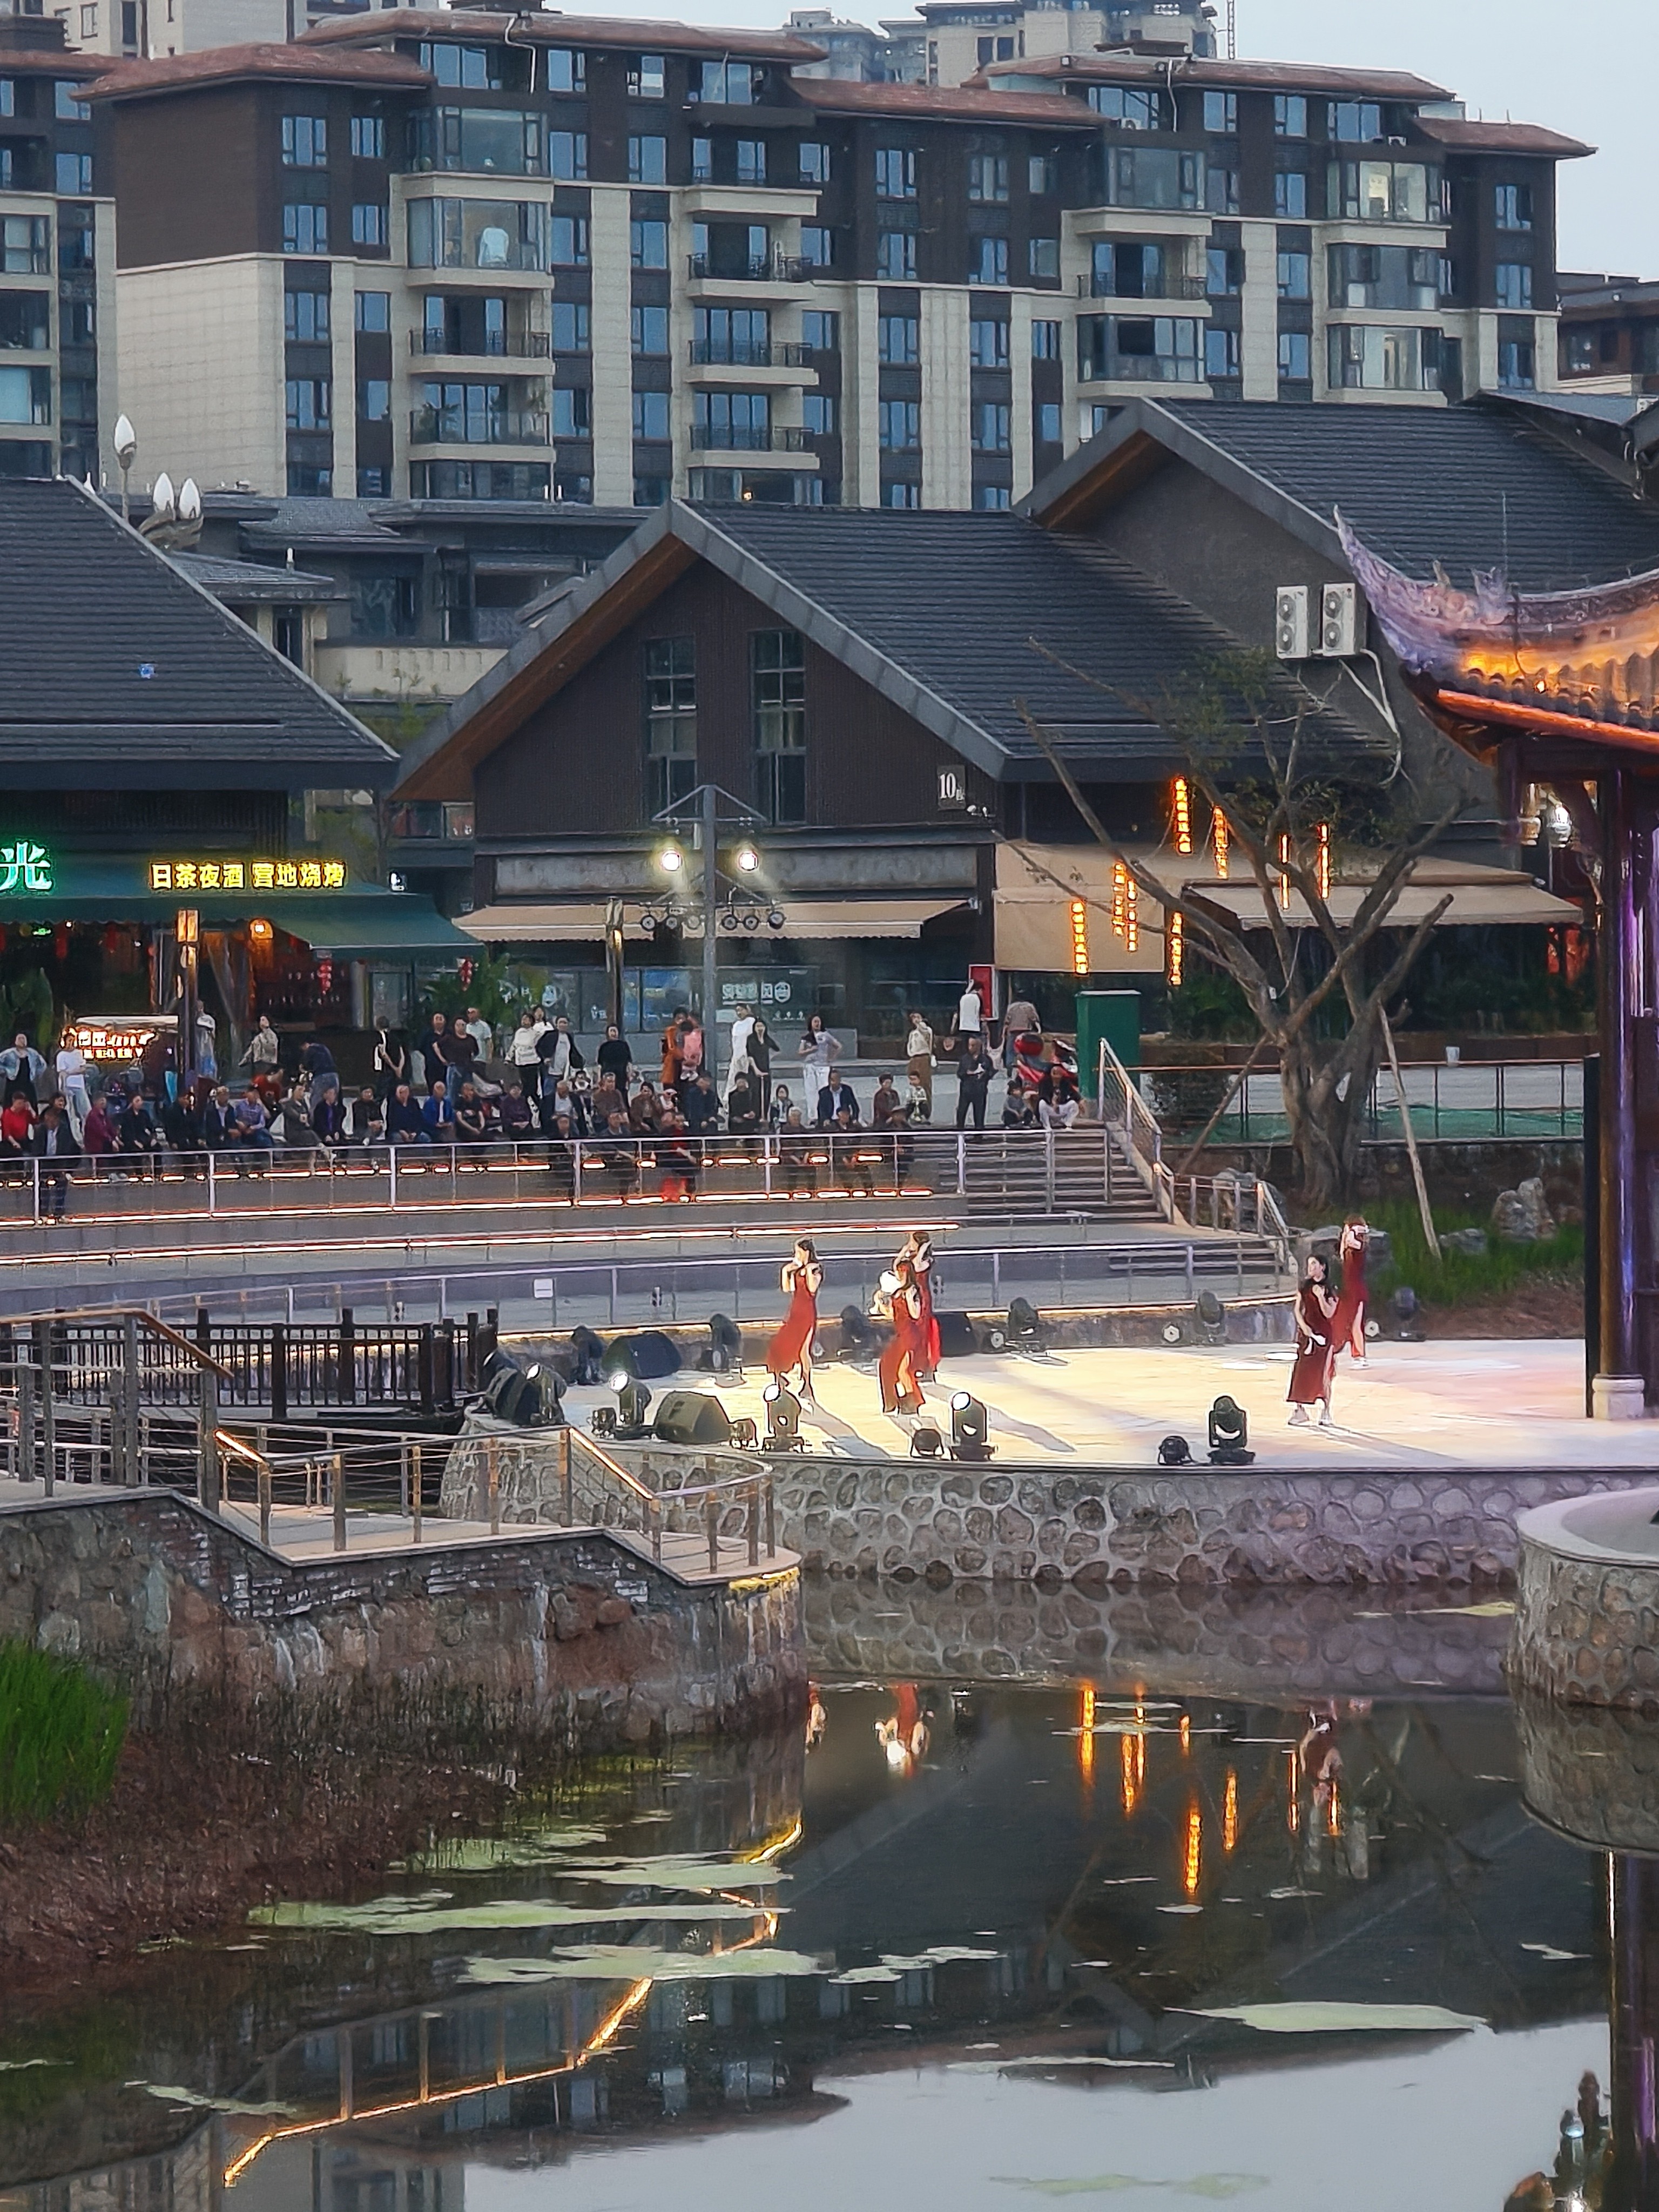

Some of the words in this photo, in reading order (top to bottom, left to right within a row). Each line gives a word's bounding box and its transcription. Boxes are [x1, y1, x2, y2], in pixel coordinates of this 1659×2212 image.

[0, 841, 52, 891] 光
[152, 863, 244, 889] 日茶夜酒
[252, 862, 344, 889] 营地烧烤
